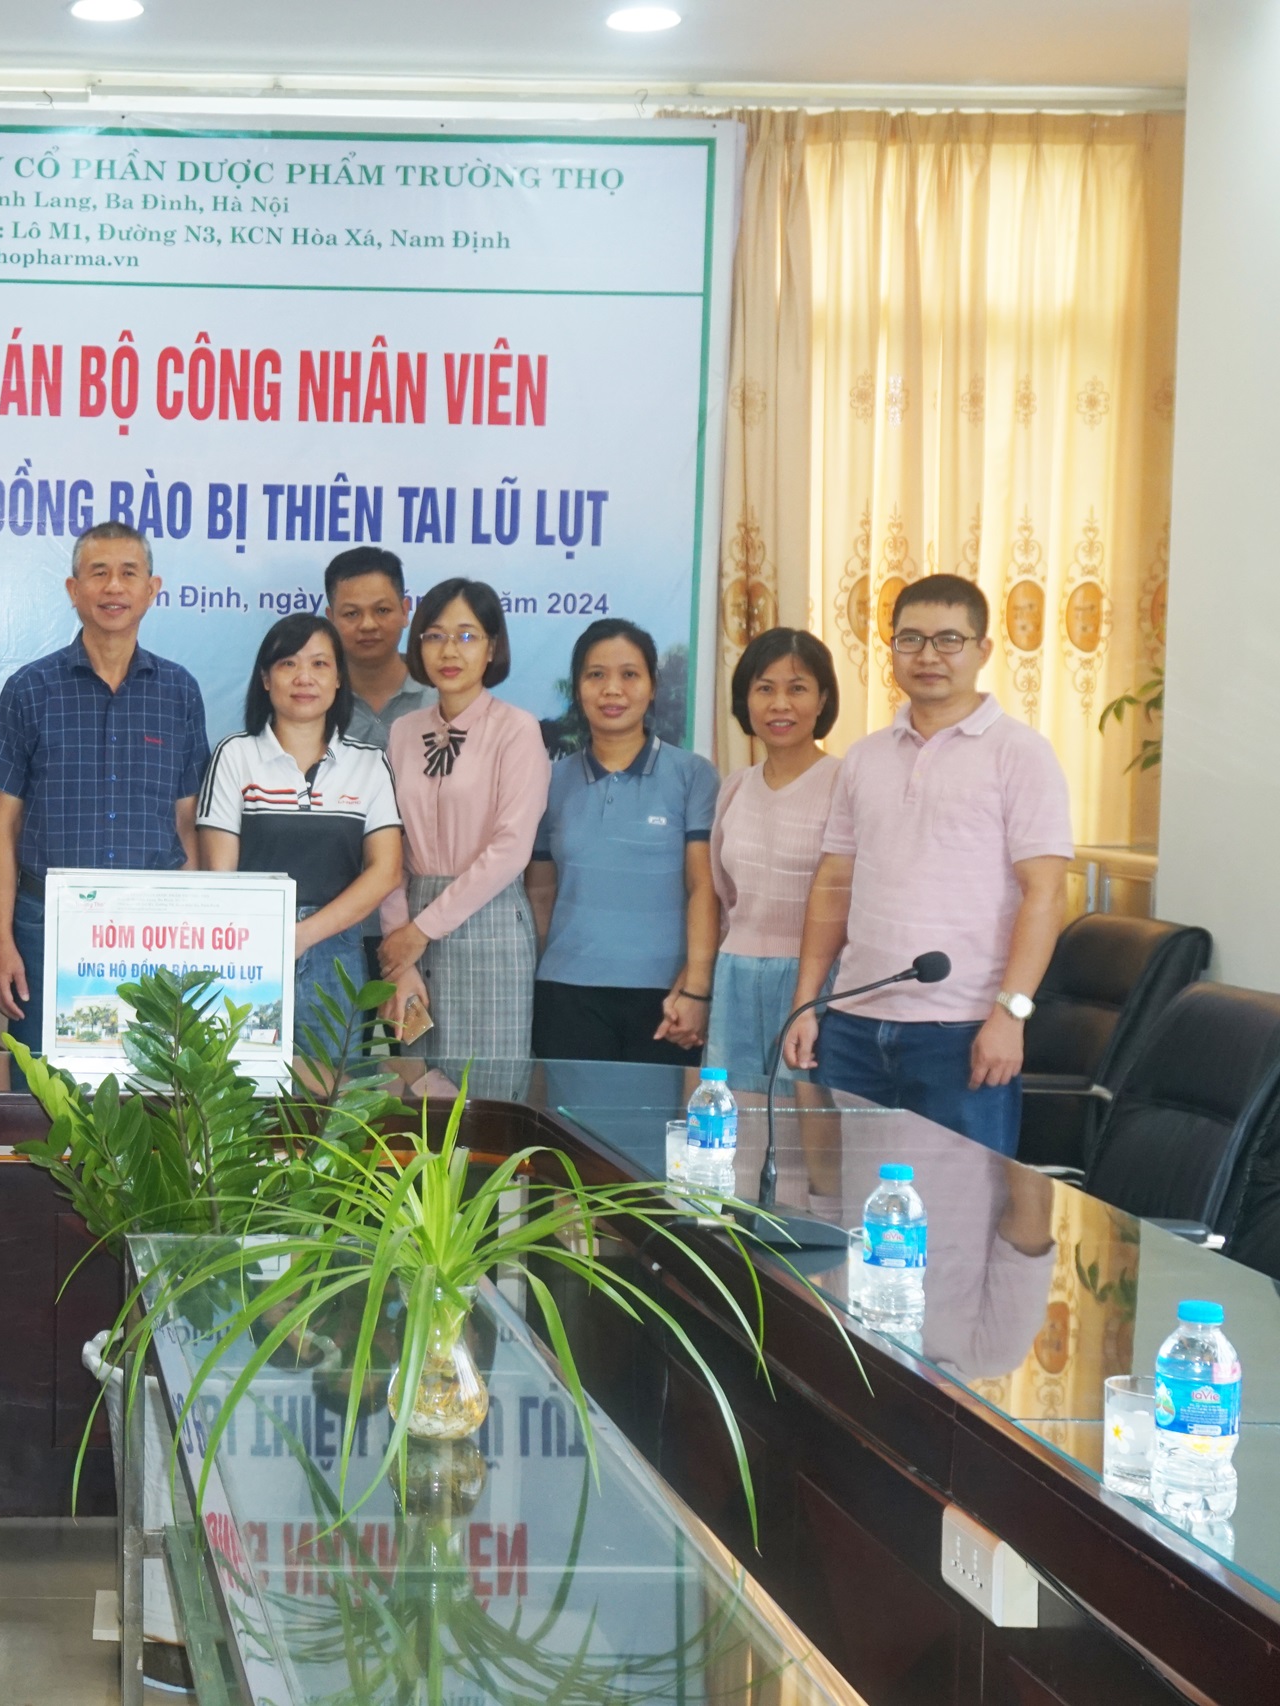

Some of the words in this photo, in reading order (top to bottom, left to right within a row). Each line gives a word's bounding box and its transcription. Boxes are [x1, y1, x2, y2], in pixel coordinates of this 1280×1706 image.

[14, 147, 60, 178] CỔ
[73, 149, 166, 181] PHẦN
[178, 159, 273, 189] DƯỢC
[287, 152, 383, 185] PHẨM
[395, 158, 539, 187] TRƯỜNG
[553, 168, 624, 195] THỌ
[35, 191, 97, 211] Lang,
[106, 193, 133, 209] Ba
[142, 194, 204, 214] Đình,
[212, 196, 242, 212] Hà
[251, 195, 289, 214] Nội
[12, 221, 41, 239] Lô
[49, 222, 90, 243] M1,
[99, 223, 177, 246] Đường
[184, 225, 222, 246] N3,
[231, 227, 283, 244] KCN
[292, 228, 337, 246] Hòa
[345, 229, 382, 249] Xá,
[390, 229, 444, 247] Nam
[453, 230, 510, 253] Định
[80, 330, 139, 435] BỘ
[157, 332, 281, 422] CÔNG
[298, 335, 427, 424] NHÂN
[444, 337, 548, 426] VIÊN
[110, 468, 192, 540] BÀO
[207, 483, 247, 553] BỊ
[263, 472, 383, 542] THIÊN
[398, 487, 456, 544] TAI
[472, 477, 520, 545] LŨ
[536, 489, 608, 559] LỤT
[179, 586, 248, 613] Định,
[259, 586, 324, 616] ngày
[501, 589, 538, 614] ăm
[548, 593, 609, 614] 2024
[92, 919, 135, 949] HÒM
[142, 921, 205, 951] QUYÊN
[211, 922, 250, 950] GÓP
[78, 957, 105, 977] ỦNG
[109, 960, 127, 981] HỘ
[220, 962, 235, 979] LŨ
[240, 965, 263, 983] LỤT
[1192, 1390, 1220, 1401] laVie
